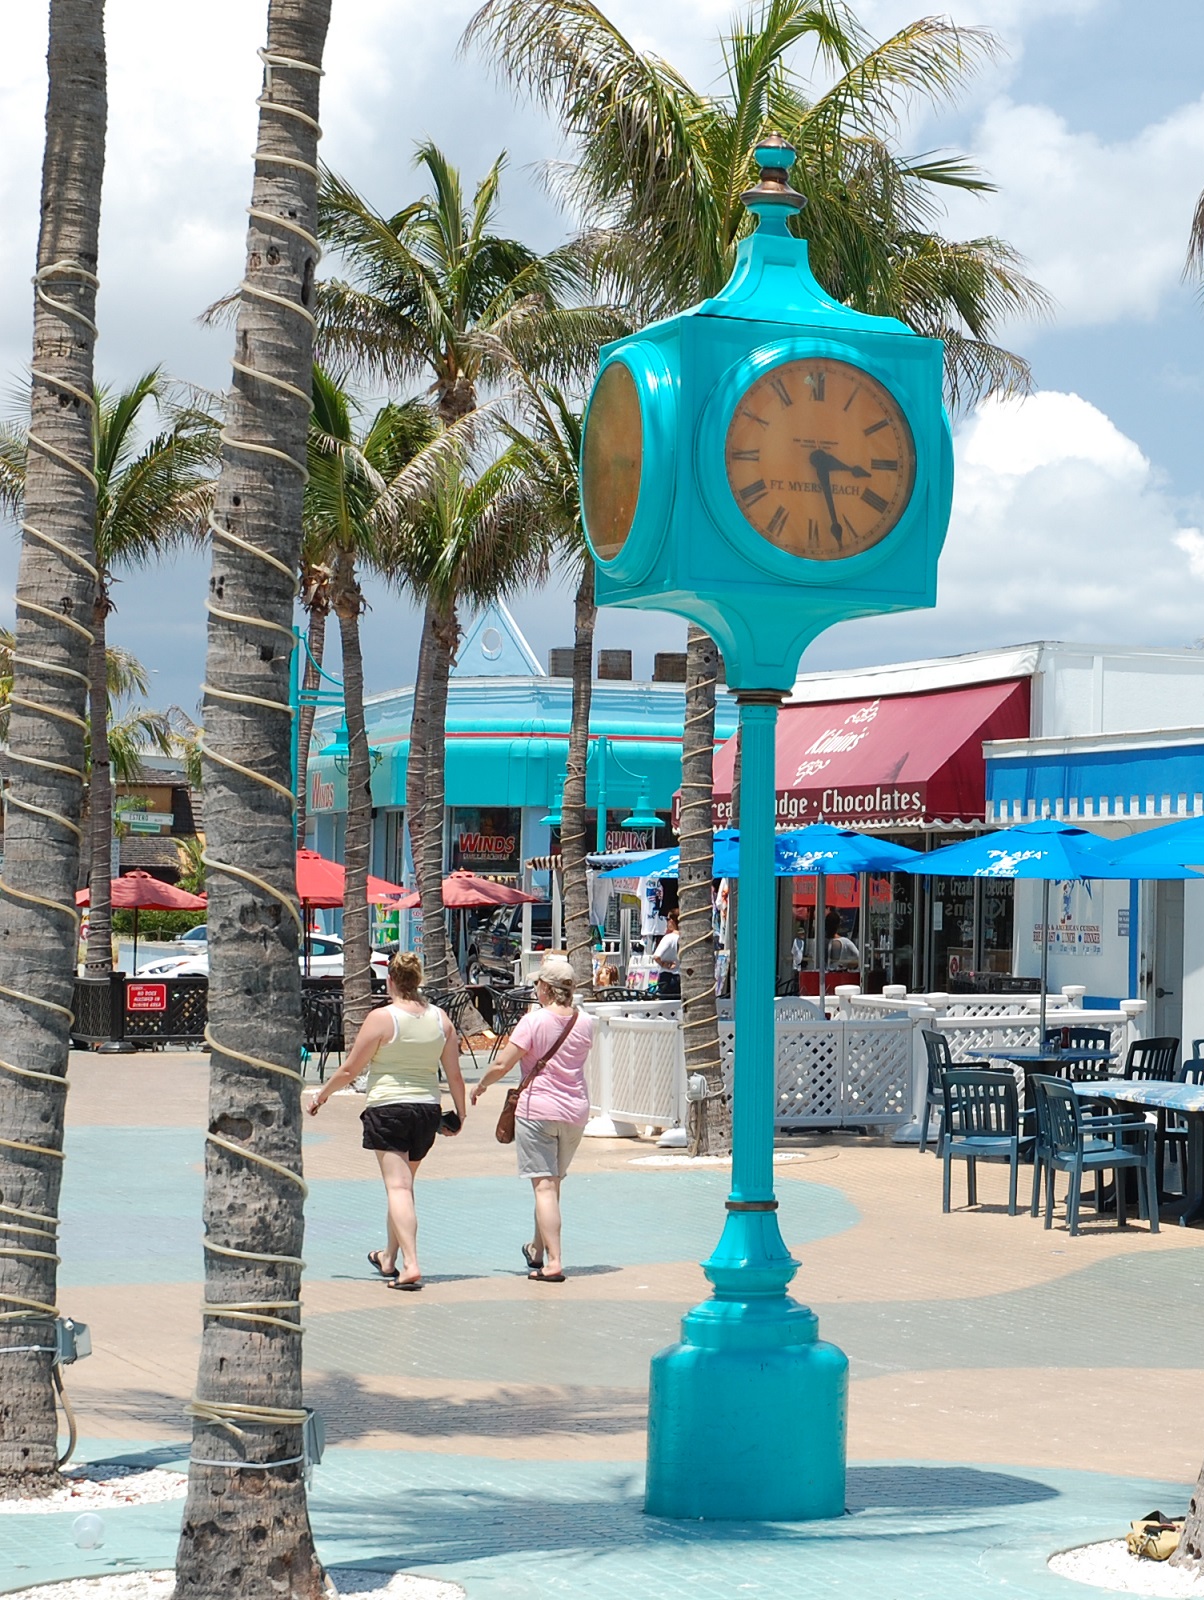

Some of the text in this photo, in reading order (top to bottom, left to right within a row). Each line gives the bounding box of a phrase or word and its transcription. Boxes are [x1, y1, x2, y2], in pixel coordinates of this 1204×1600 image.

[770, 480, 860, 495] FT. MYERS EACH
[775, 791, 808, 819] dge
[459, 832, 516, 854] WINDS
[605, 831, 647, 850] CHAIRS
